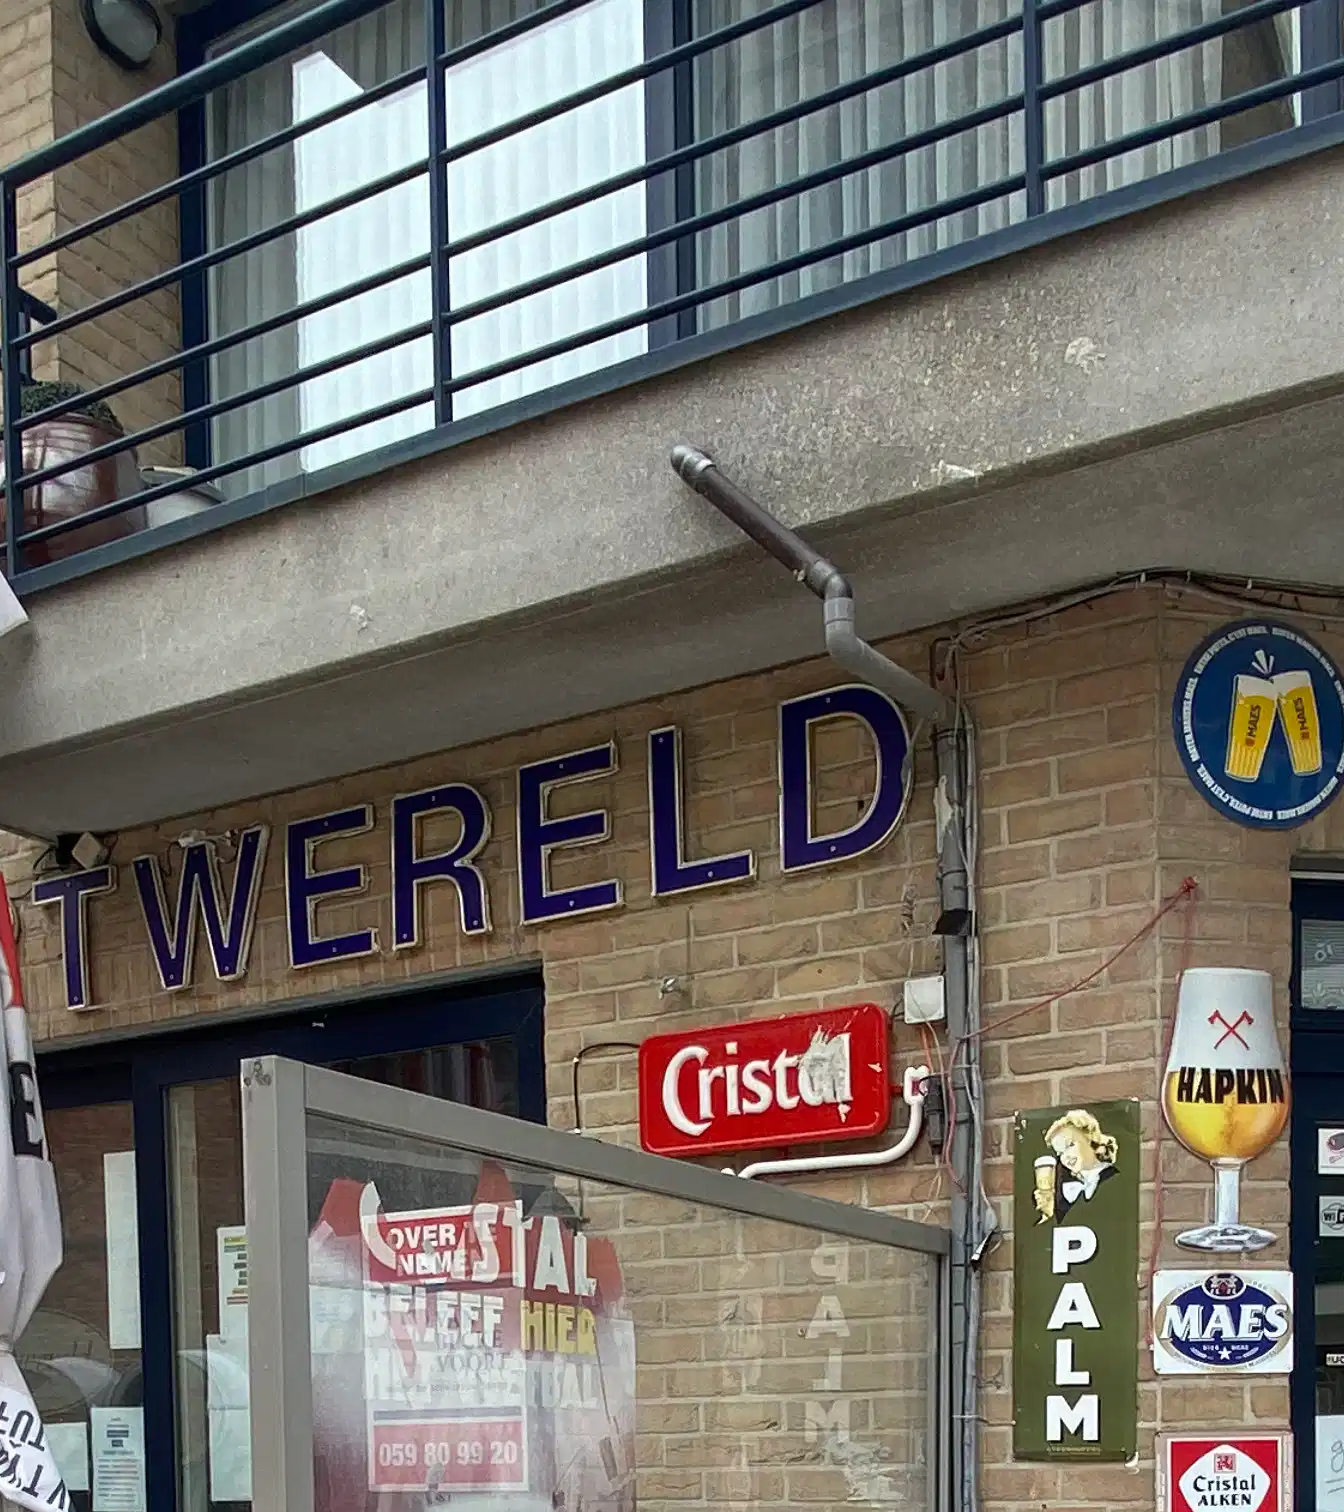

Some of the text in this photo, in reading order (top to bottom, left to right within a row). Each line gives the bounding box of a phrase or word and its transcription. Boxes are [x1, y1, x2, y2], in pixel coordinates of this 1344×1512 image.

[662, 1032, 854, 1136] Cristal
[1177, 1066, 1285, 1105] HAPKIN
[387, 1222, 456, 1250] OVER
[520, 1300, 598, 1355] HIER
[1047, 1226, 1101, 1441] PALM
[1159, 1304, 1289, 1342] MAES
[378, 1440, 518, 1467] 059 80 99 20
[1193, 1474, 1255, 1492] Cristal
[1198, 1493, 1252, 1506] ALKEN
